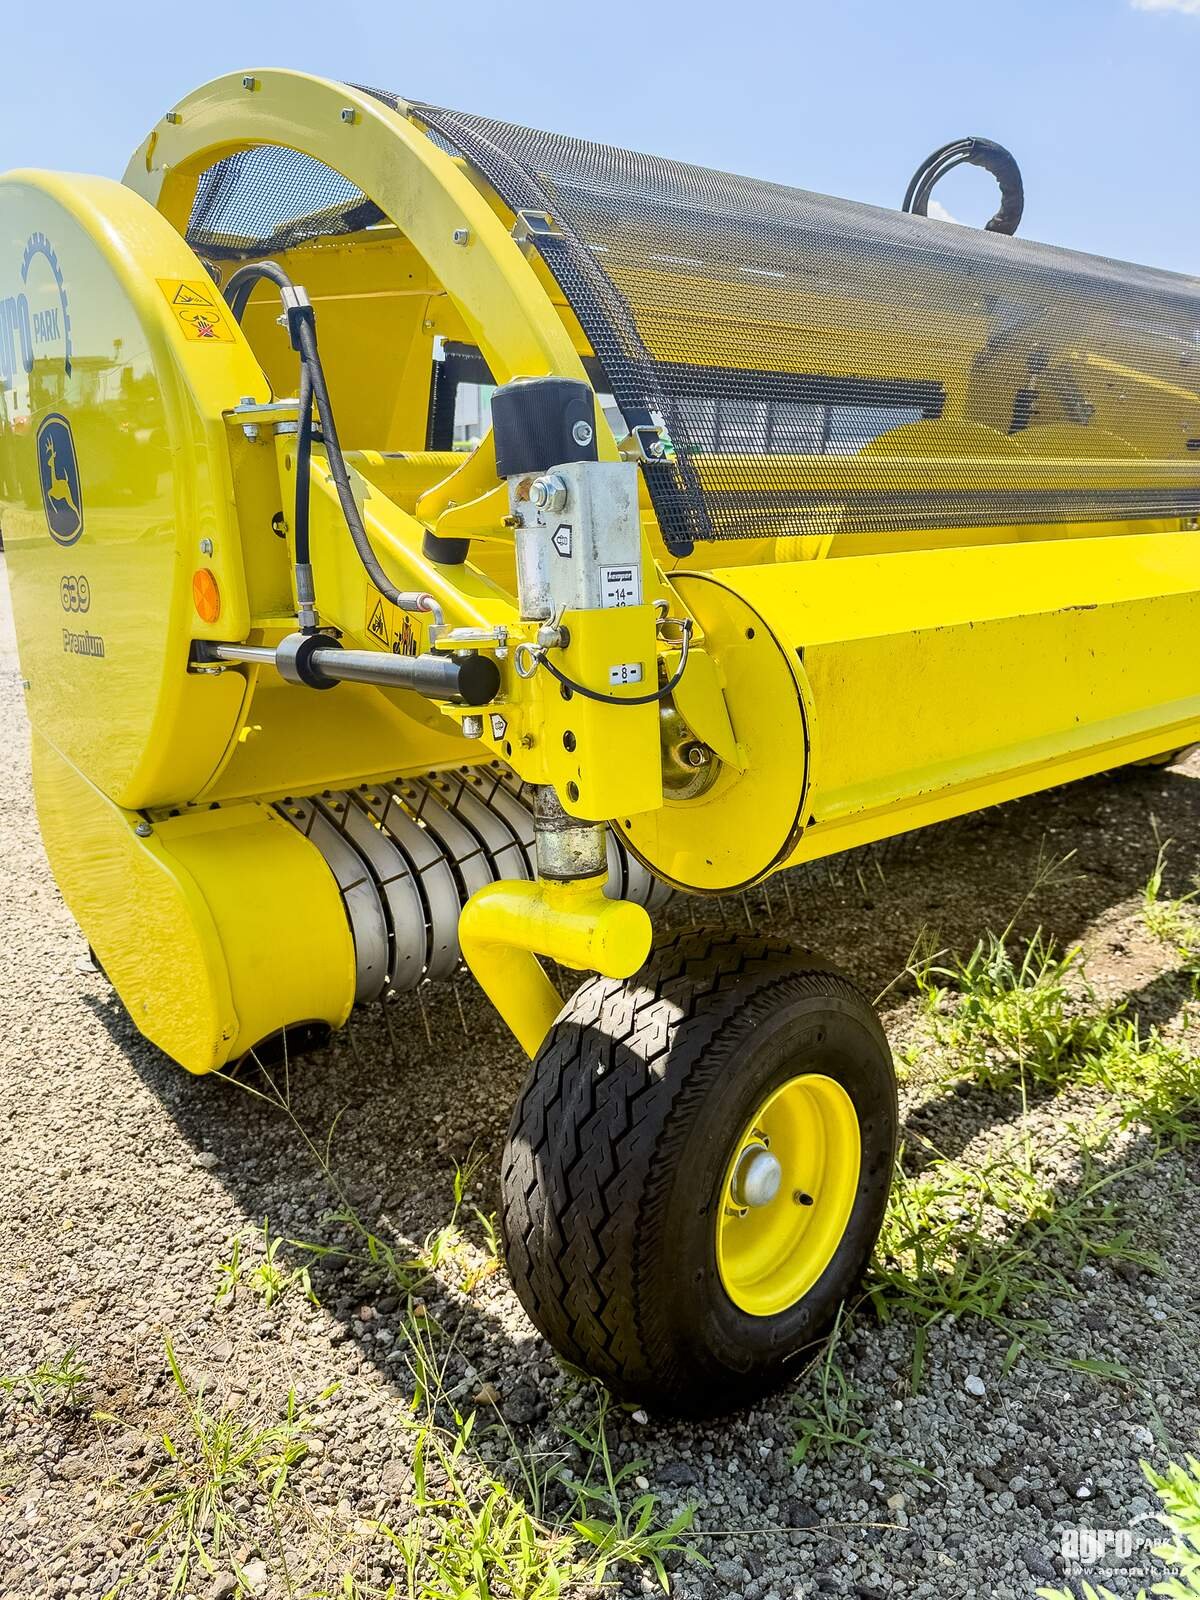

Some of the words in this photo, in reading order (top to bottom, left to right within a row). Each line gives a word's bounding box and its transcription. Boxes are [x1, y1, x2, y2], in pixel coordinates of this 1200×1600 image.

[33, 308, 61, 344] PARK
[60, 575, 91, 613] 639
[62, 628, 105, 658] Premium
